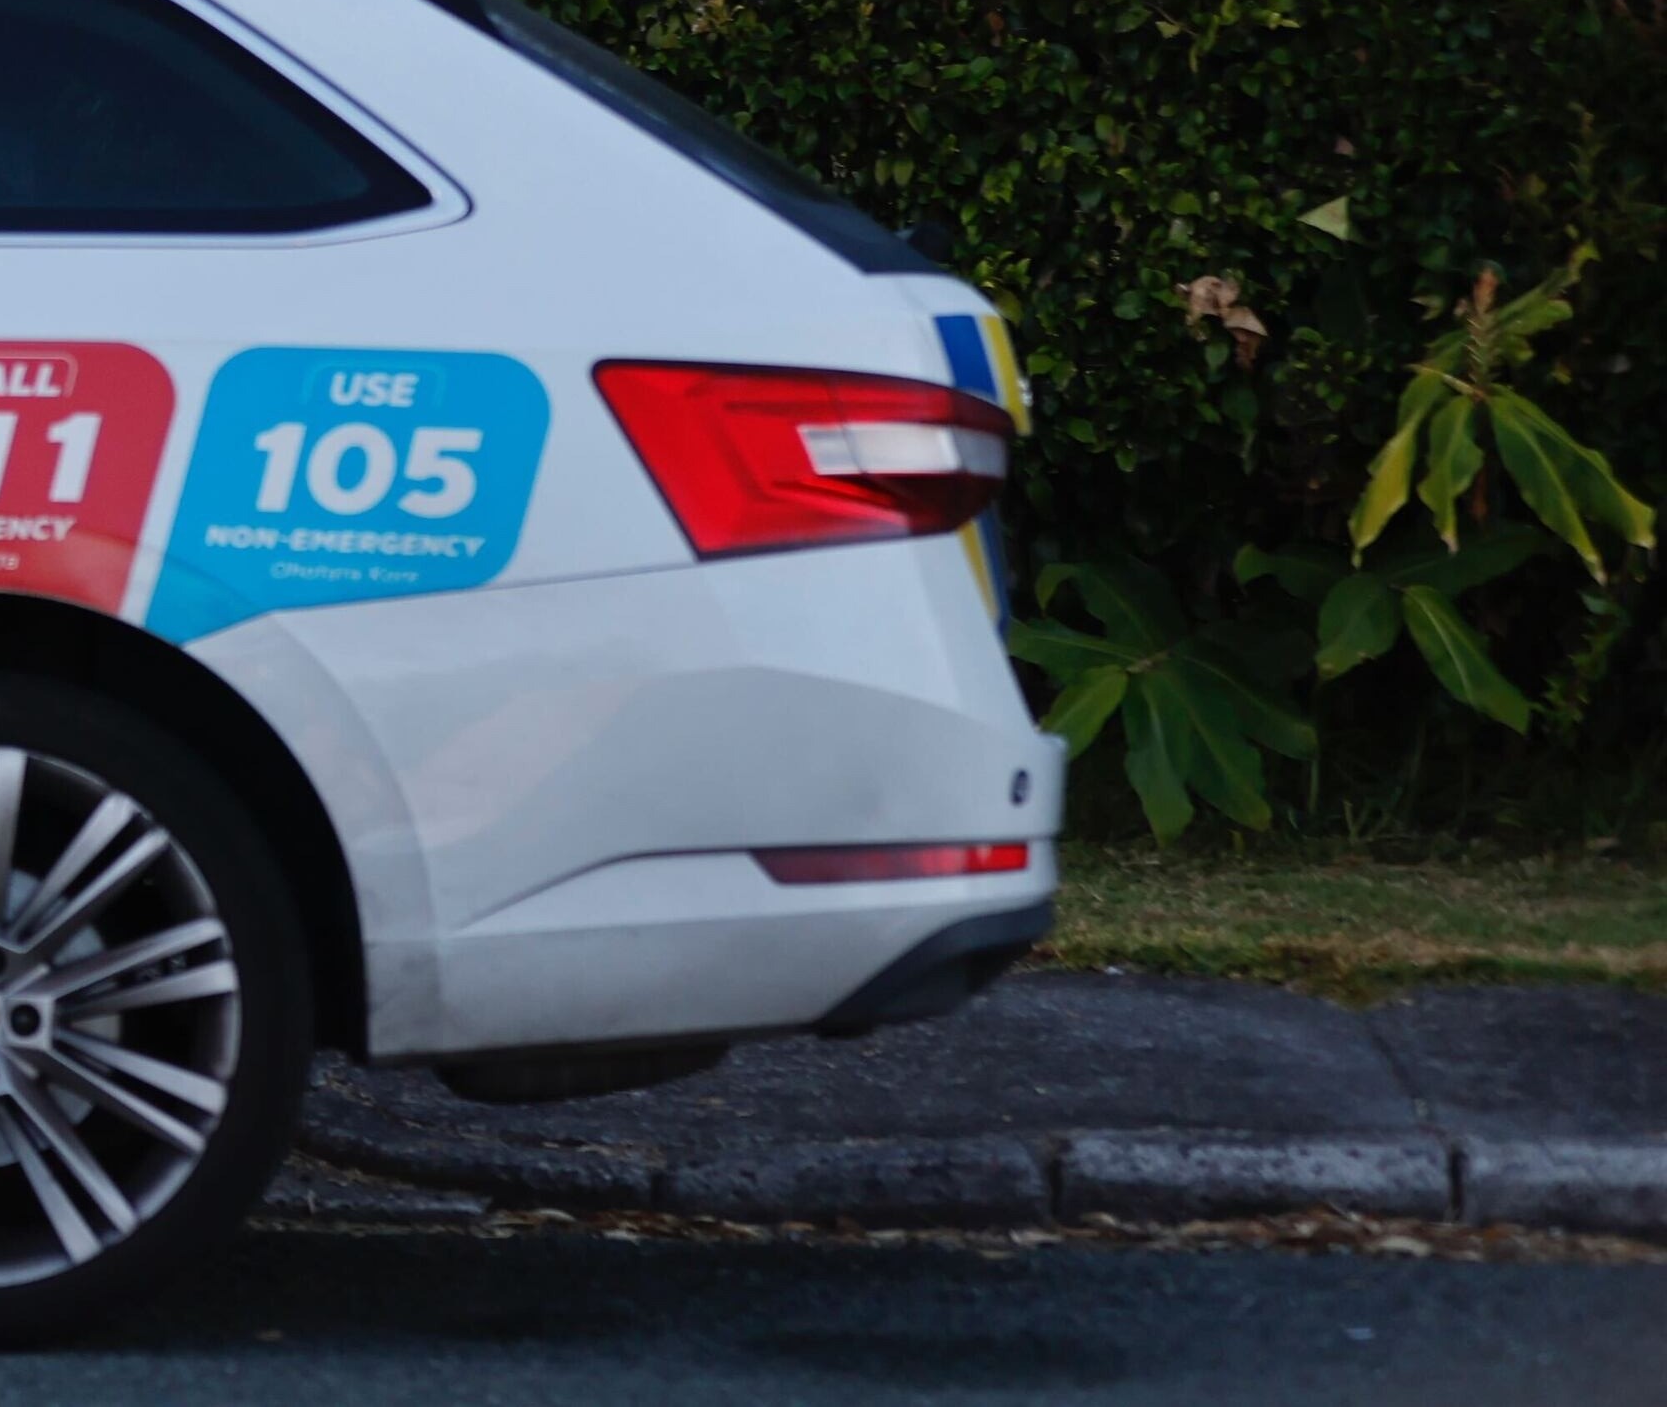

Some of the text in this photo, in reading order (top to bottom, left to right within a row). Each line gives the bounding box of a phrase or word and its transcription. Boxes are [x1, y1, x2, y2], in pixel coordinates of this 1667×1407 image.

[329, 371, 419, 408] USE
[254, 421, 484, 519] 105
[205, 524, 486, 558] NON-EMERGENCY
